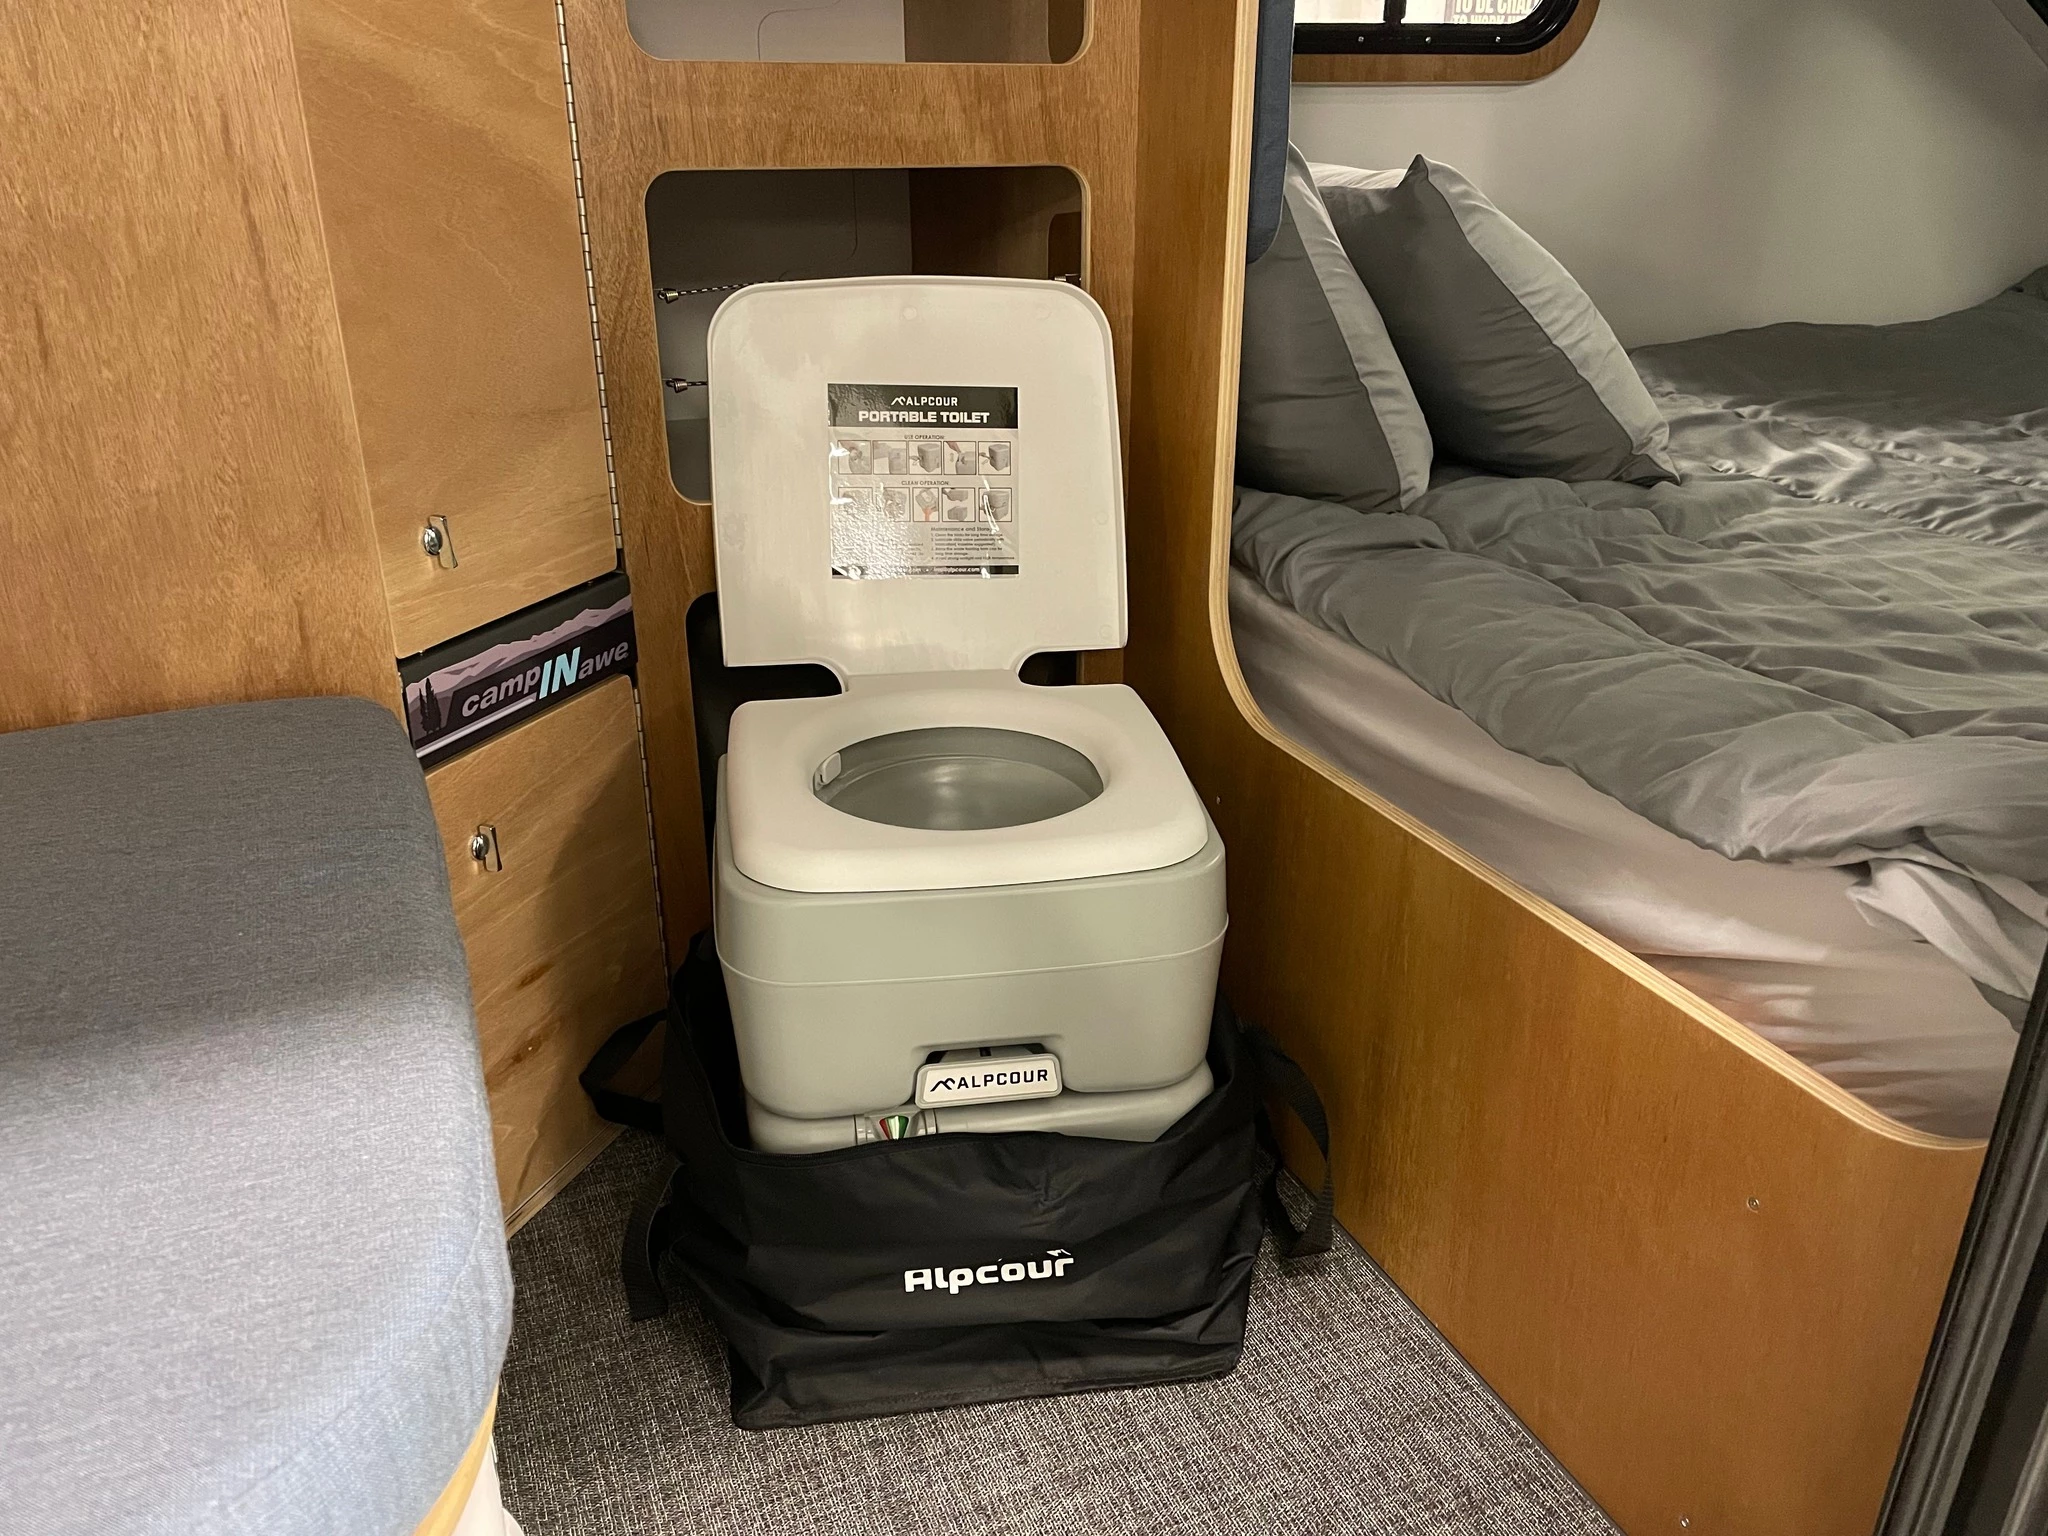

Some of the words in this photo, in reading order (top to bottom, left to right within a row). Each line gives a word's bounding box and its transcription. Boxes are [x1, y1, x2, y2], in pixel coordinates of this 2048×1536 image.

[906, 396, 958, 407] ALPCOUR
[858, 410, 937, 423] PORTABLE
[940, 412, 990, 423] TOILET
[957, 1069, 1048, 1090] ALPCOUR
[904, 1257, 1074, 1294] Alpcour
